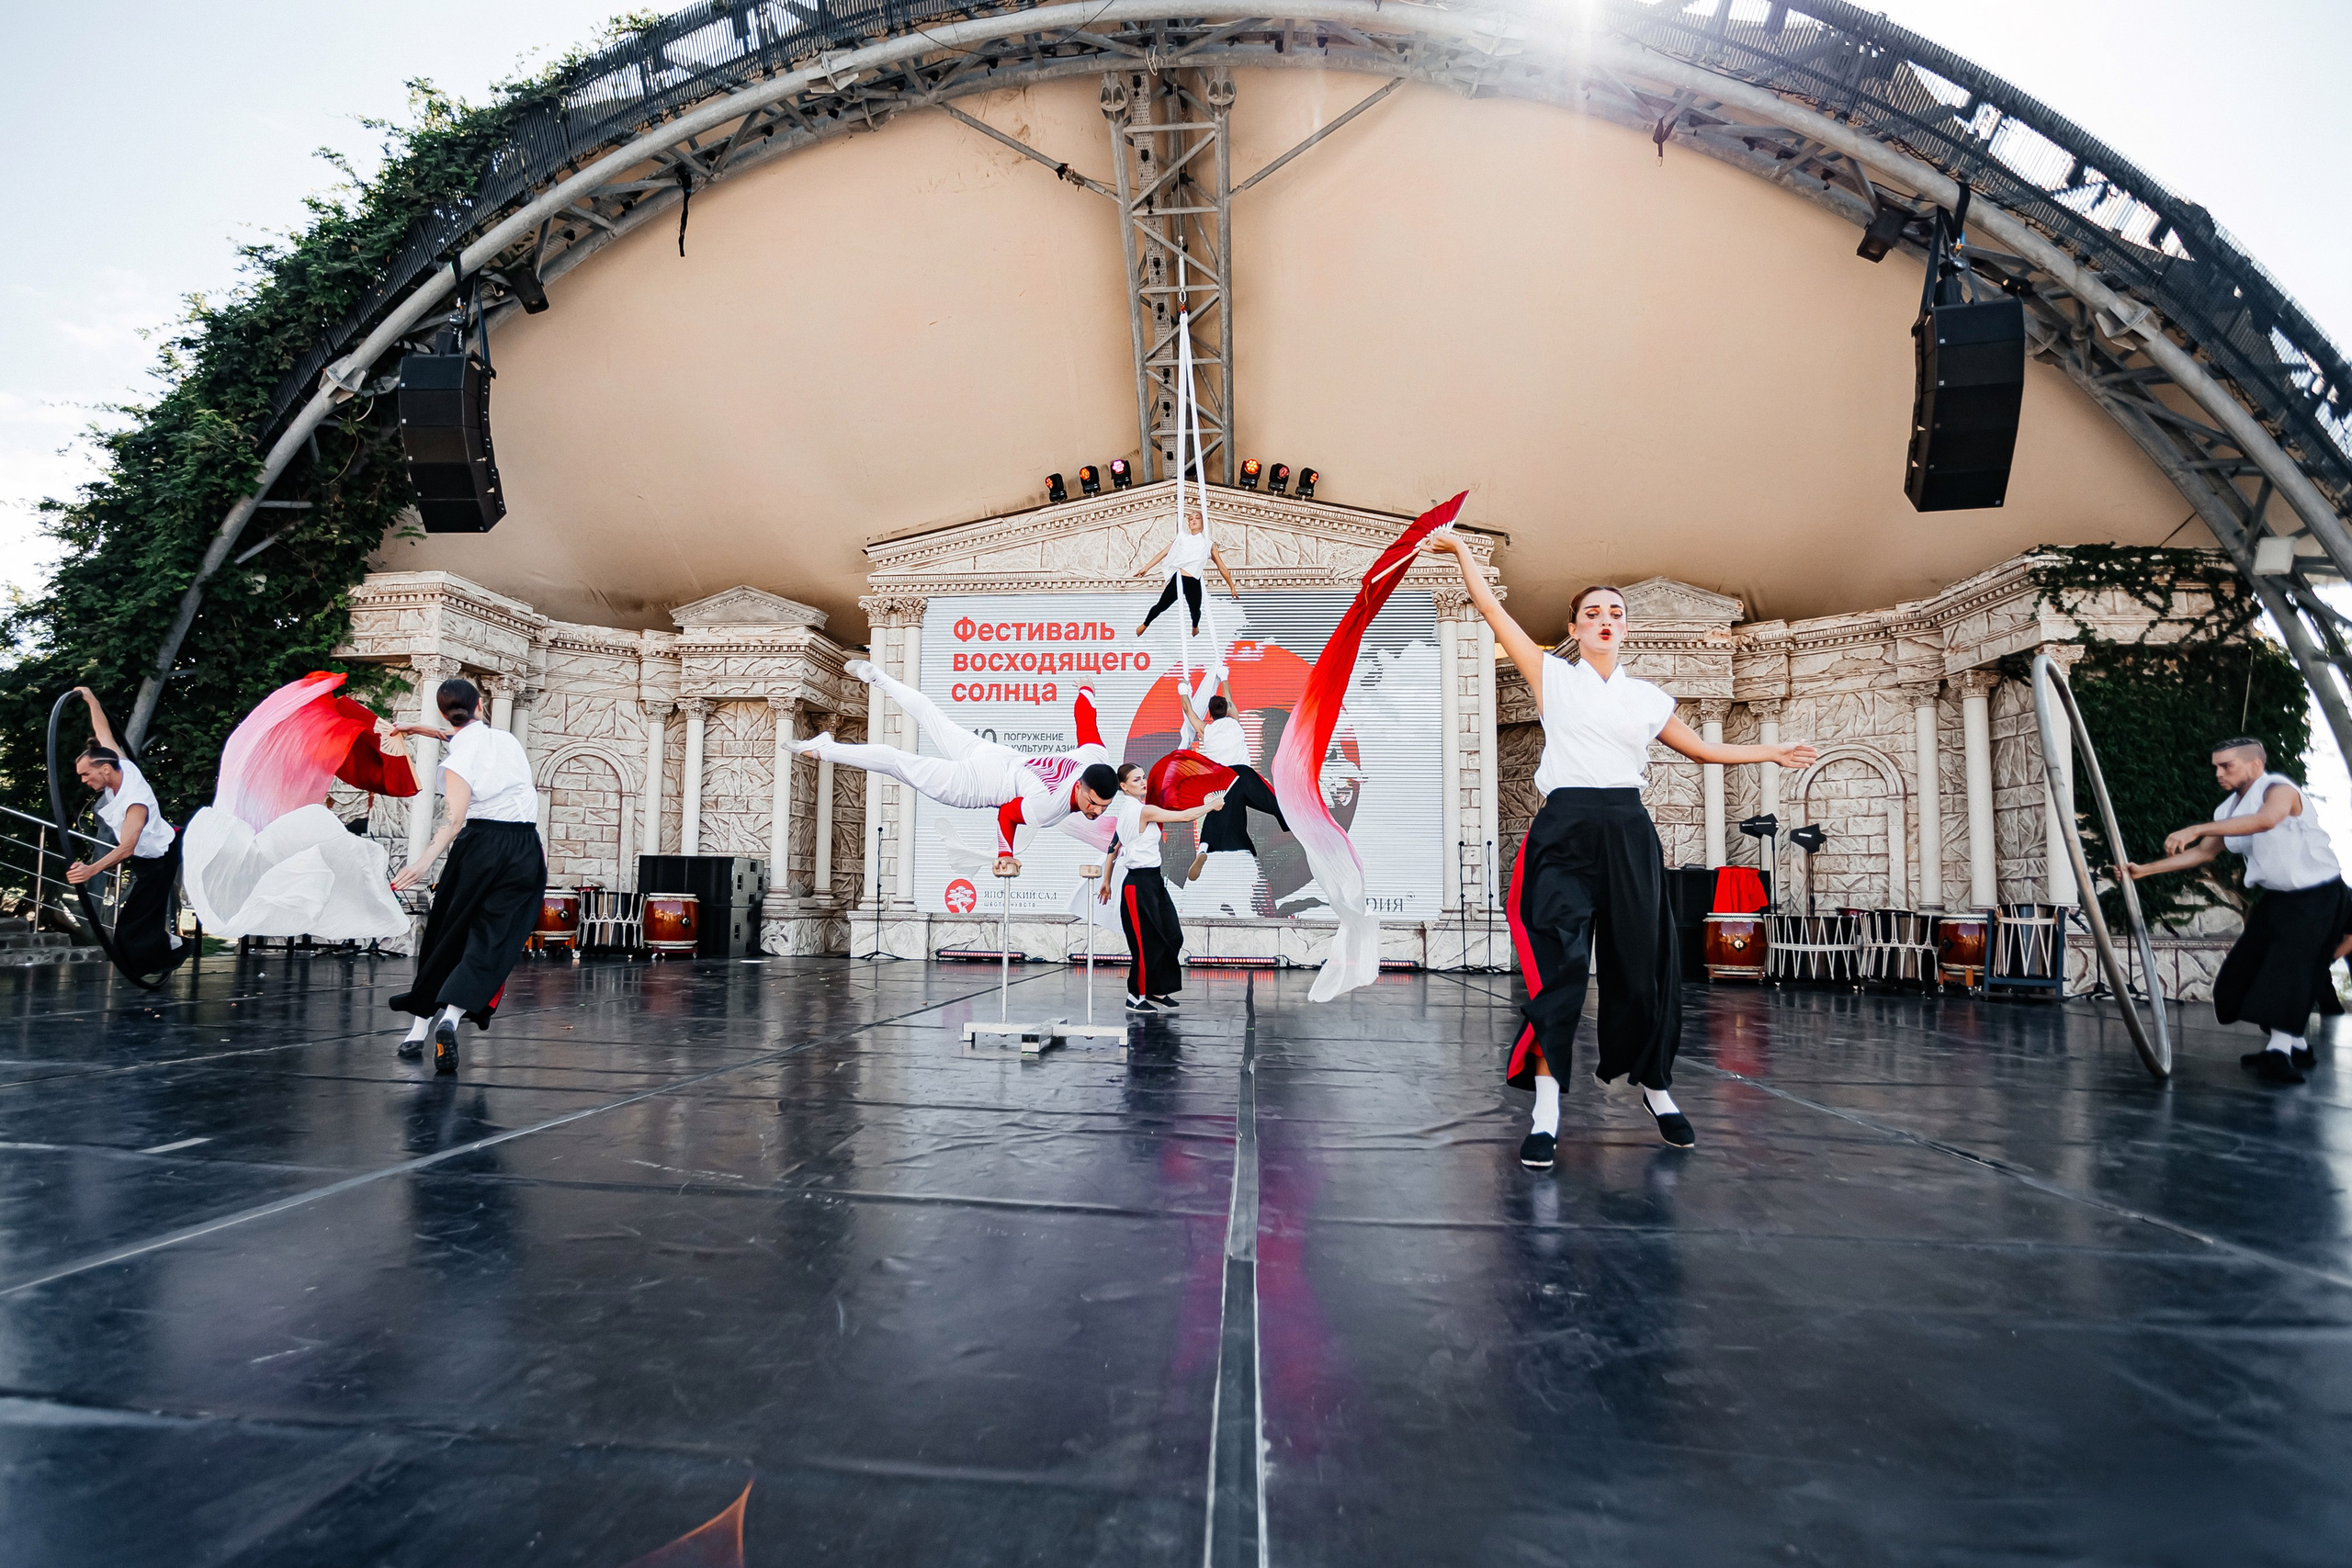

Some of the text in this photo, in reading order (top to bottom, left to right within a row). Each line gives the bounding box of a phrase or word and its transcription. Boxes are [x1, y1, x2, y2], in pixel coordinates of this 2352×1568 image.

[953, 616, 1115, 642] Фестиваль
[953, 652, 1150, 674] восходящего
[951, 682, 1057, 705] солнца
[1003, 732, 1064, 741] ПОГРУЖЕНИЕ
[984, 890, 1057, 900] ЯПОСКИЙ САД
